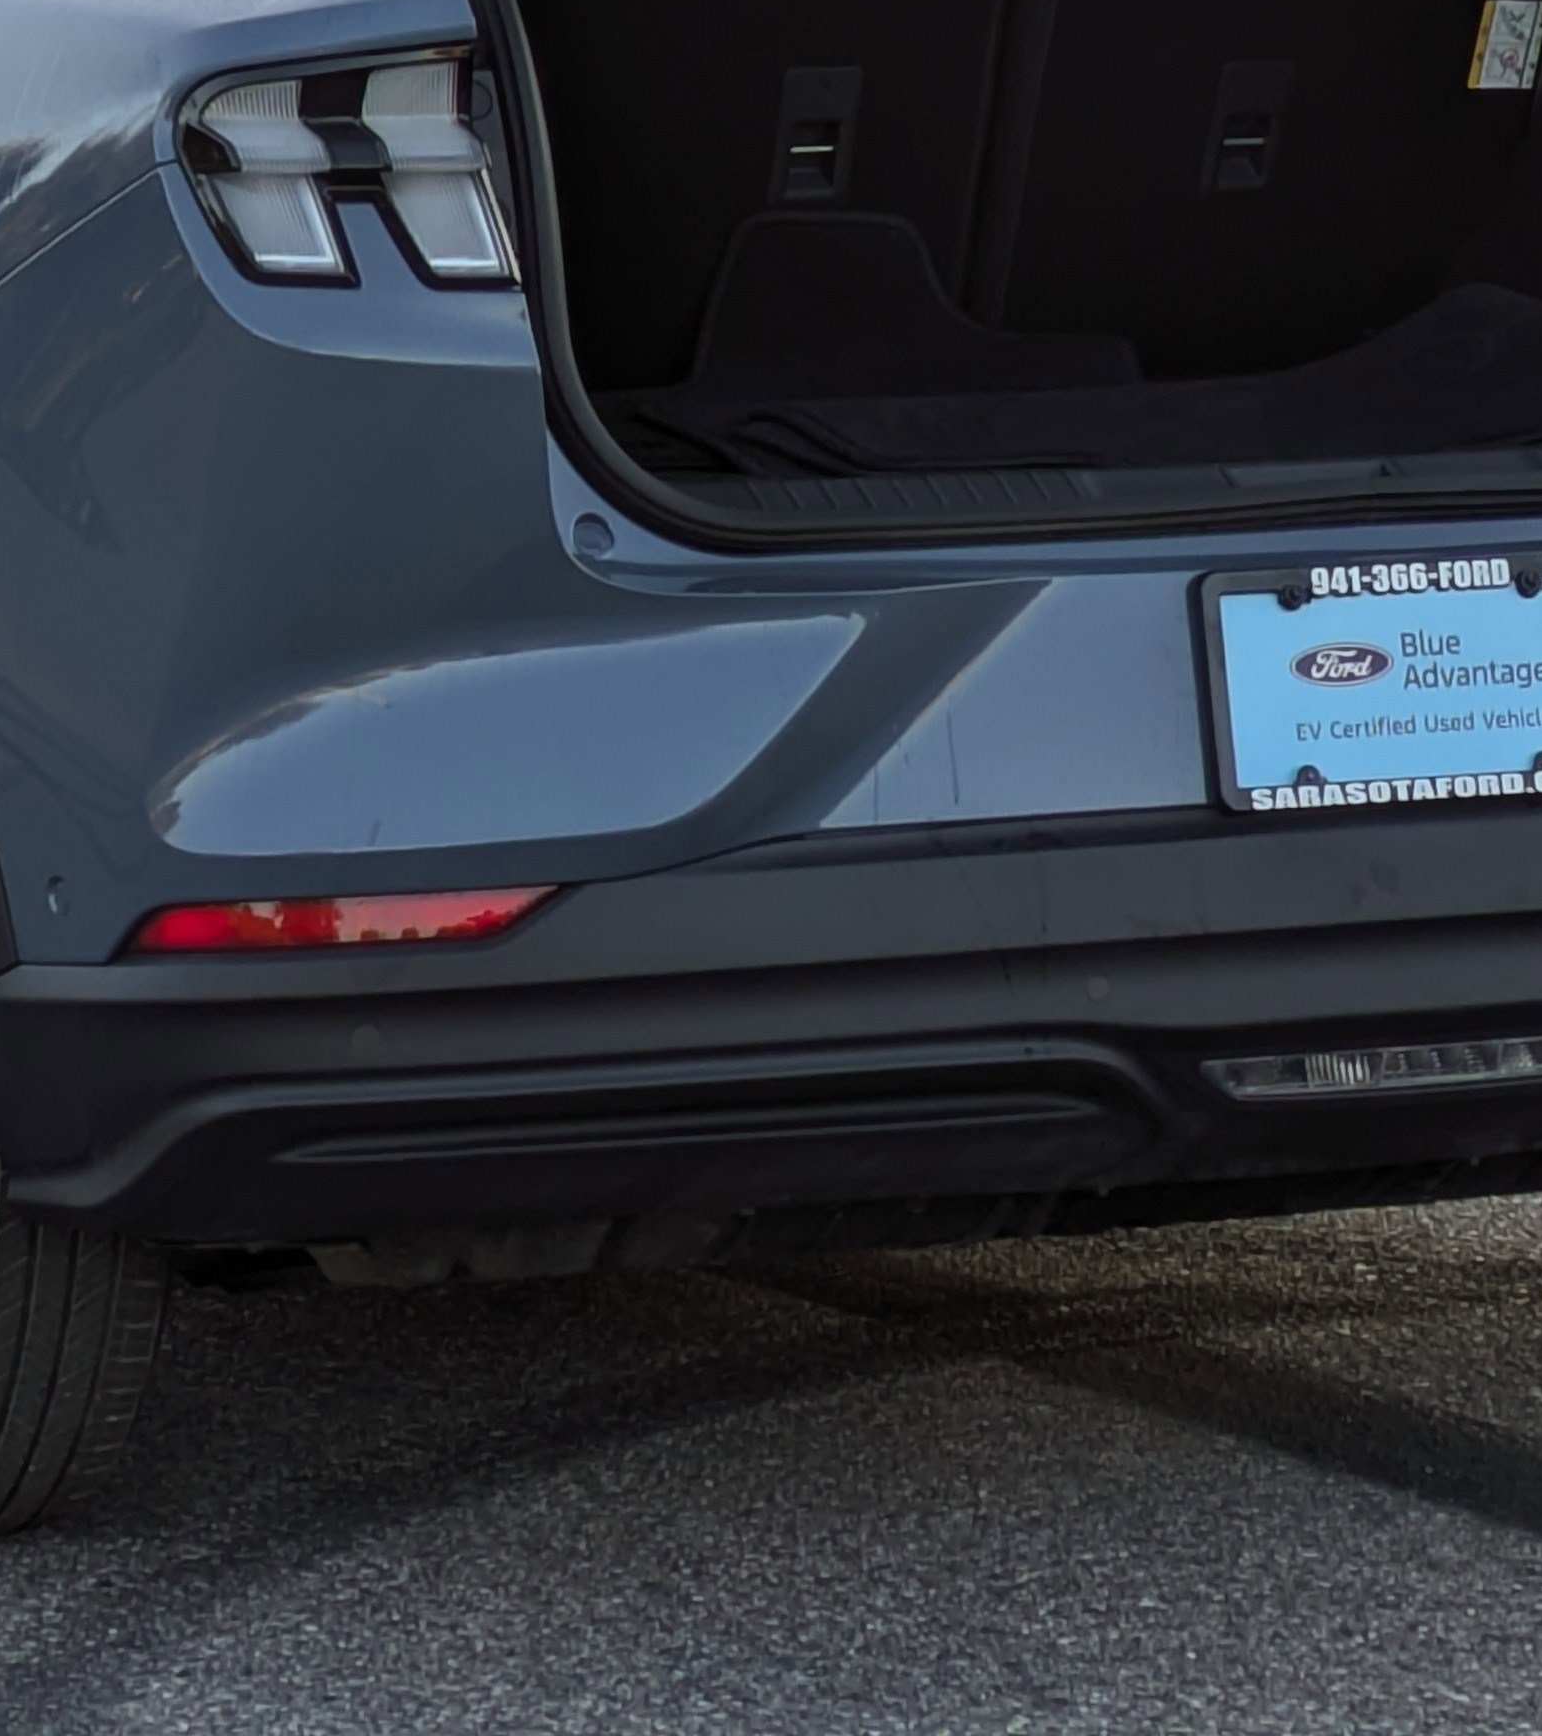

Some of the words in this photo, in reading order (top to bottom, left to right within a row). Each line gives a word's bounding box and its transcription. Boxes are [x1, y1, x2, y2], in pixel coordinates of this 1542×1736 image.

[1310, 558, 1511, 597] 941-366-FORD
[1400, 629, 1461, 658] Blue
[1296, 721, 1322, 742] EV
[1330, 716, 1416, 740] Certified
[1424, 712, 1475, 734] Used
